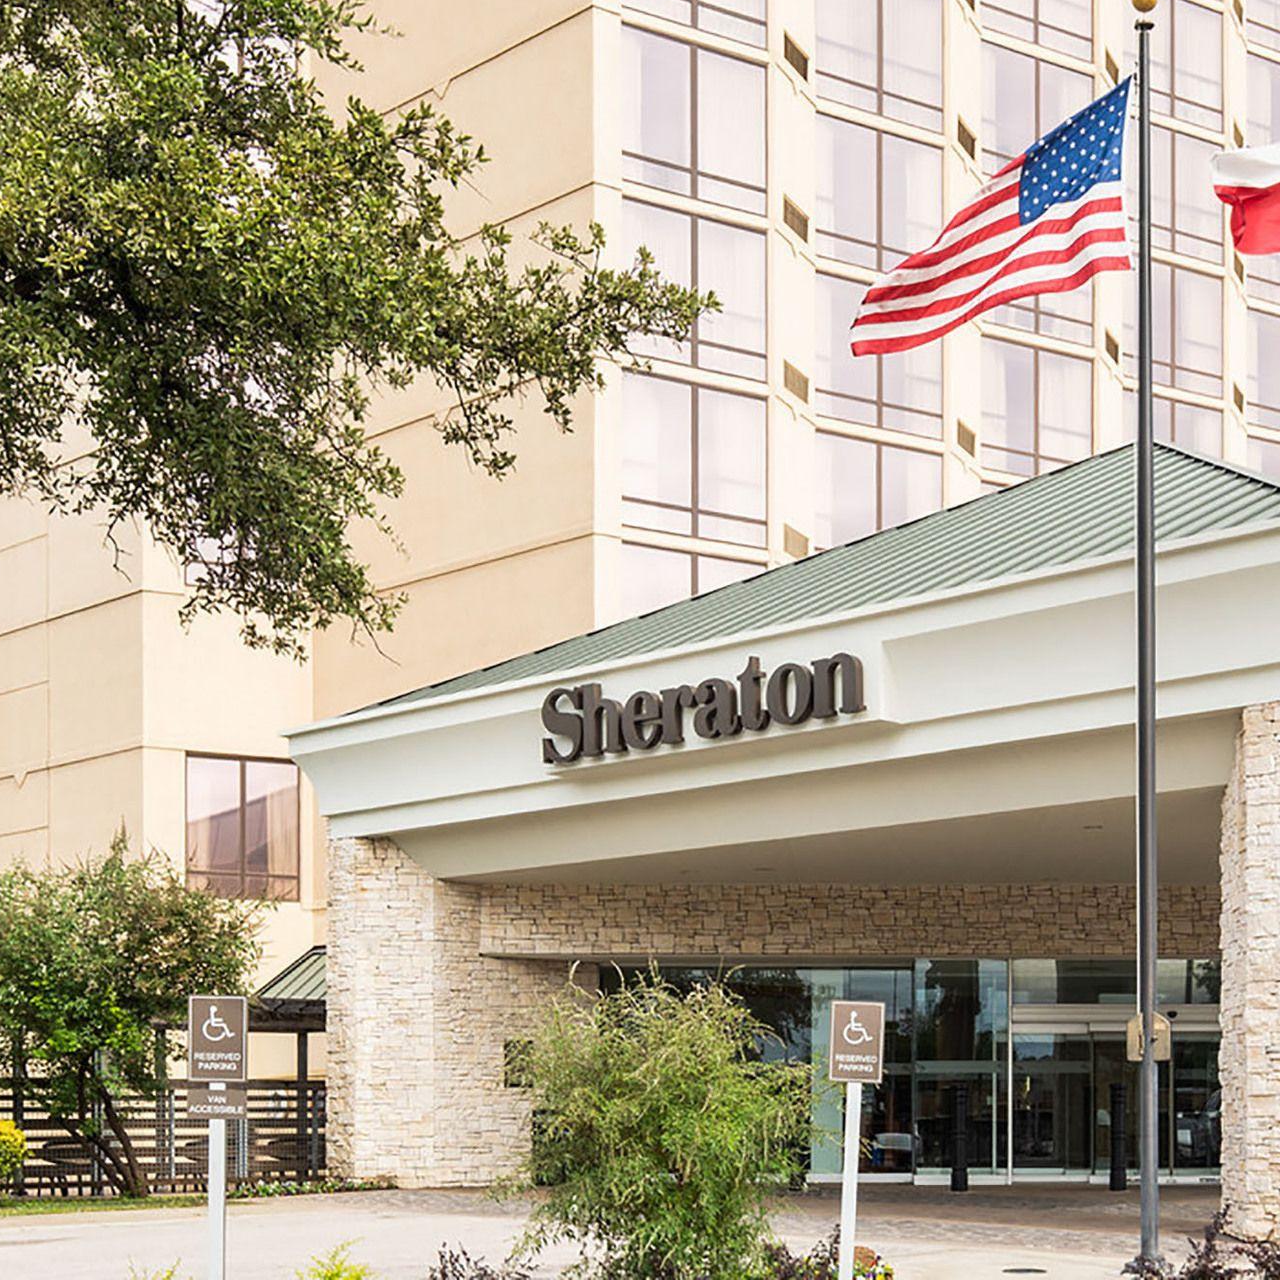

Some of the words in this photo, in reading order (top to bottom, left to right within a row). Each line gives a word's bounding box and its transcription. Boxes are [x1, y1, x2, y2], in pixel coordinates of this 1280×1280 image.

[541, 652, 866, 764] Sheraton
[193, 1052, 241, 1062] RESERVED
[835, 1054, 878, 1064] RESERVED
[198, 1062, 237, 1071] PARKING
[838, 1063, 874, 1073] PARKING
[207, 1095, 227, 1104] VAN
[189, 1105, 243, 1114] ACCESSIBLE
